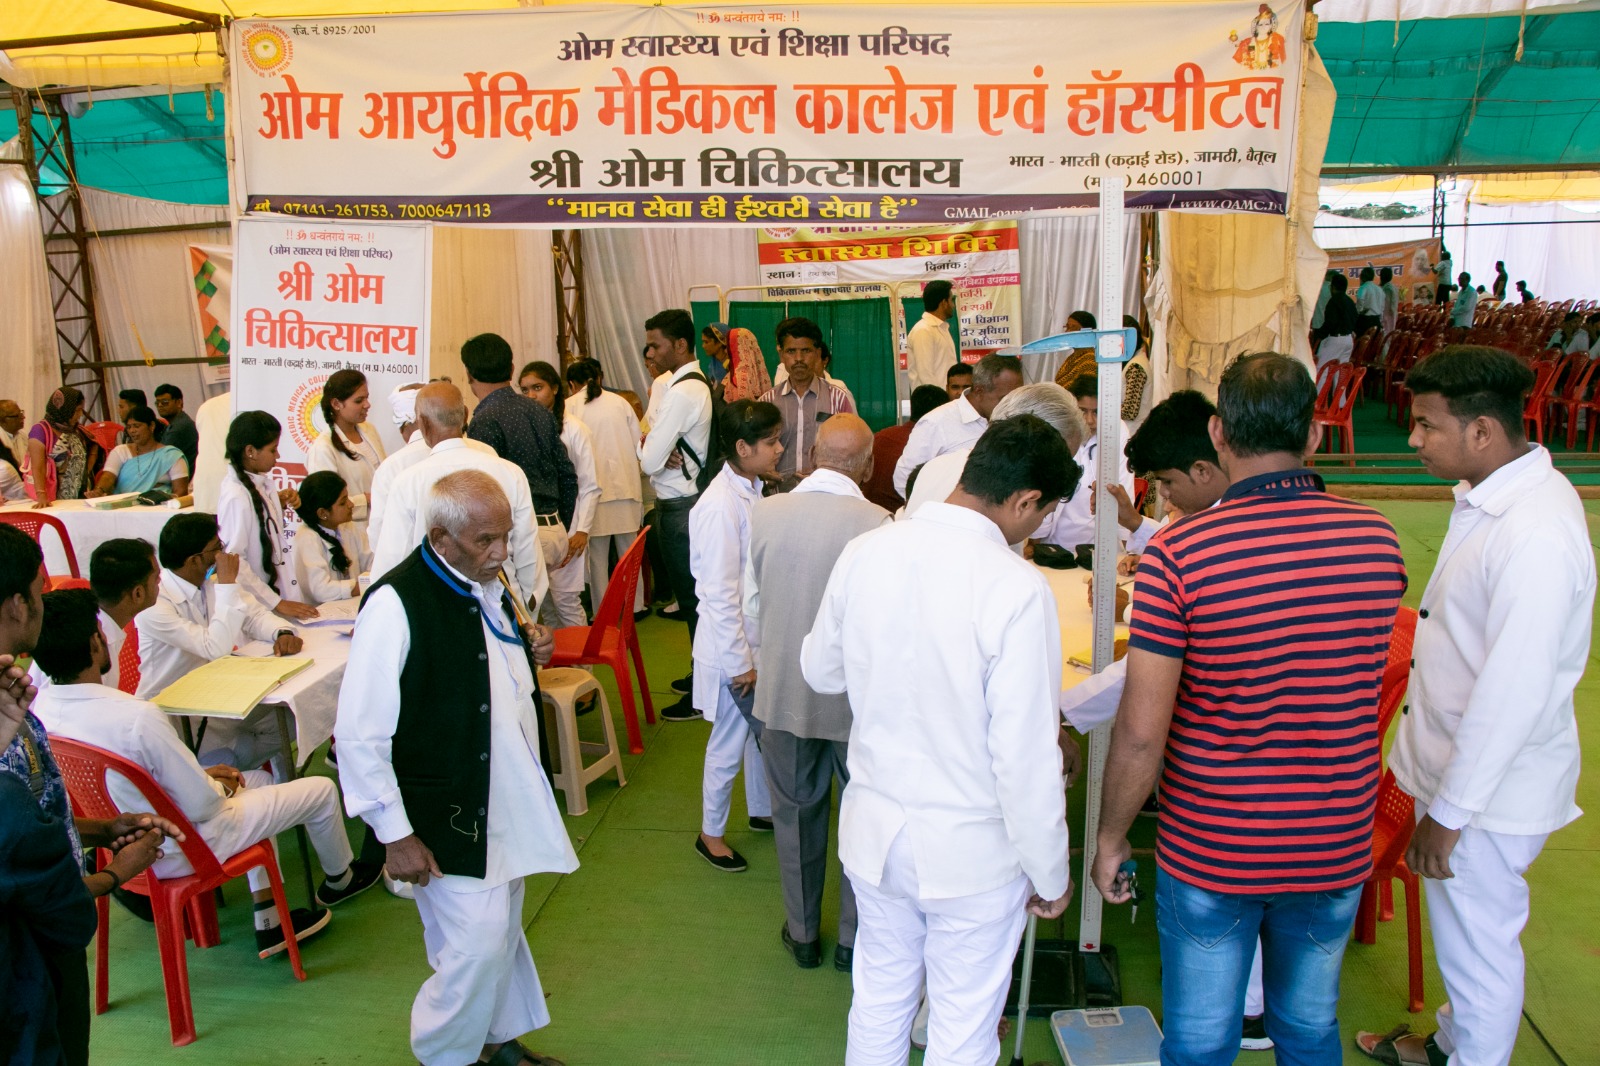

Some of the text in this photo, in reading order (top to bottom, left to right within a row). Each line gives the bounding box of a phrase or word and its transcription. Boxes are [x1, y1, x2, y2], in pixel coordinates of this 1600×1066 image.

[323, 25, 377, 36] 8925/2001
[557, 26, 953, 62] ओम स्वास्थ्य एवं शिक्षा परिषद
[258, 61, 1285, 160] ओम आयुर्वेदिक मेडिकल कालेज एवं हॉस्पीटल
[529, 147, 965, 189] श्री ओम चिकित्सालय
[1009, 153, 1045, 168] भारत
[1060, 151, 1101, 168] भारती
[1137, 170, 1203, 188] 460001
[398, 202, 492, 219] 7000647113
[642, 196, 693, 219] सेवा
[700, 195, 726, 219] ही
[734, 195, 811, 222] ईश्वरी
[819, 196, 873, 219] सेवा
[325, 245, 338, 258] एवं
[339, 246, 360, 259] शिक्षा
[778, 233, 1001, 265] स्वास्थ्य शिविर
[277, 261, 385, 305] श्री ओम
[244, 307, 418, 356] चिकित्सालय
[241, 357, 257, 366] भारत
[264, 356, 283, 367] भारती
[387, 364, 418, 375] 460001
[287, 382, 308, 413] MEDICAL
